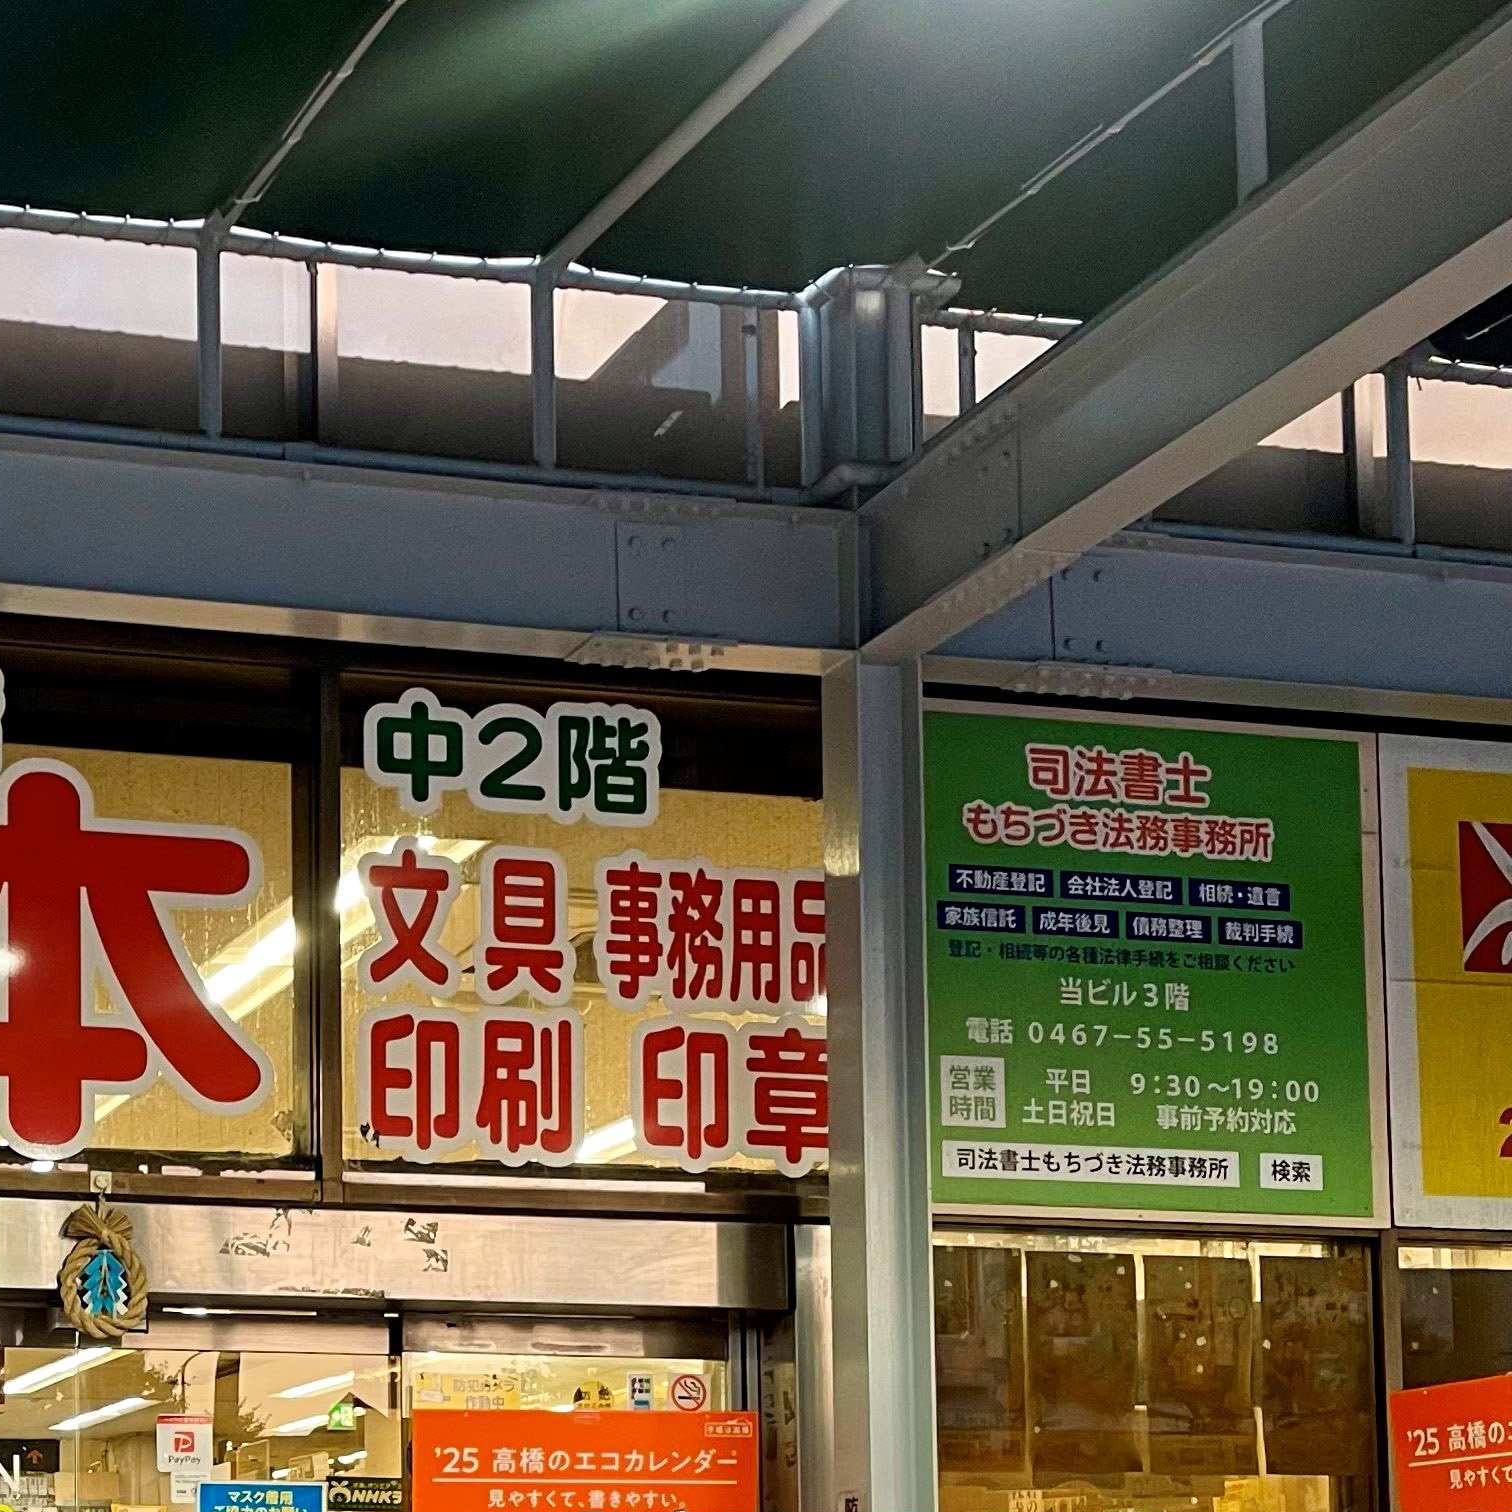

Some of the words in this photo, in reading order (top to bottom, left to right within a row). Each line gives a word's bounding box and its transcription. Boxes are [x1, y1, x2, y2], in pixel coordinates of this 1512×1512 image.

[372, 697, 654, 819] 中2階
[1025, 744, 1211, 808] 司法書士
[963, 799, 1275, 863] もちづき法務事務所
[955, 868, 1046, 894] 不動産登記
[1066, 875, 1174, 901] 会社法人登記
[1197, 883, 1282, 908] 相続・遺言
[366, 847, 566, 996] 文具
[944, 906, 1017, 929] 家族信託
[1039, 910, 1111, 934] 成年後見
[1132, 915, 1204, 939] 債務整理
[1224, 920, 1295, 944] 裁判手続
[965, 1017, 1014, 1046] 電話
[1027, 1020, 1281, 1056] 0467-55-5198
[369, 1012, 574, 1155] 印刷
[640, 1024, 829, 1165] 印章
[948, 1064, 997, 1092] 営業
[1045, 1067, 1092, 1095] 平日
[948, 1095, 997, 1123] 時間
[1022, 1099, 1117, 1128] 土日祝日
[1155, 1103, 1297, 1137] 事前予約対応
[956, 1147, 1230, 1182] 司法書士もちづき法務事務所
[1270, 1158, 1312, 1185] 検索
[168, 1455, 201, 1466] PayPay
[491, 1447, 738, 1475] 高橋のエコカレンダー
[227, 1489, 294, 1506] マスク着用
